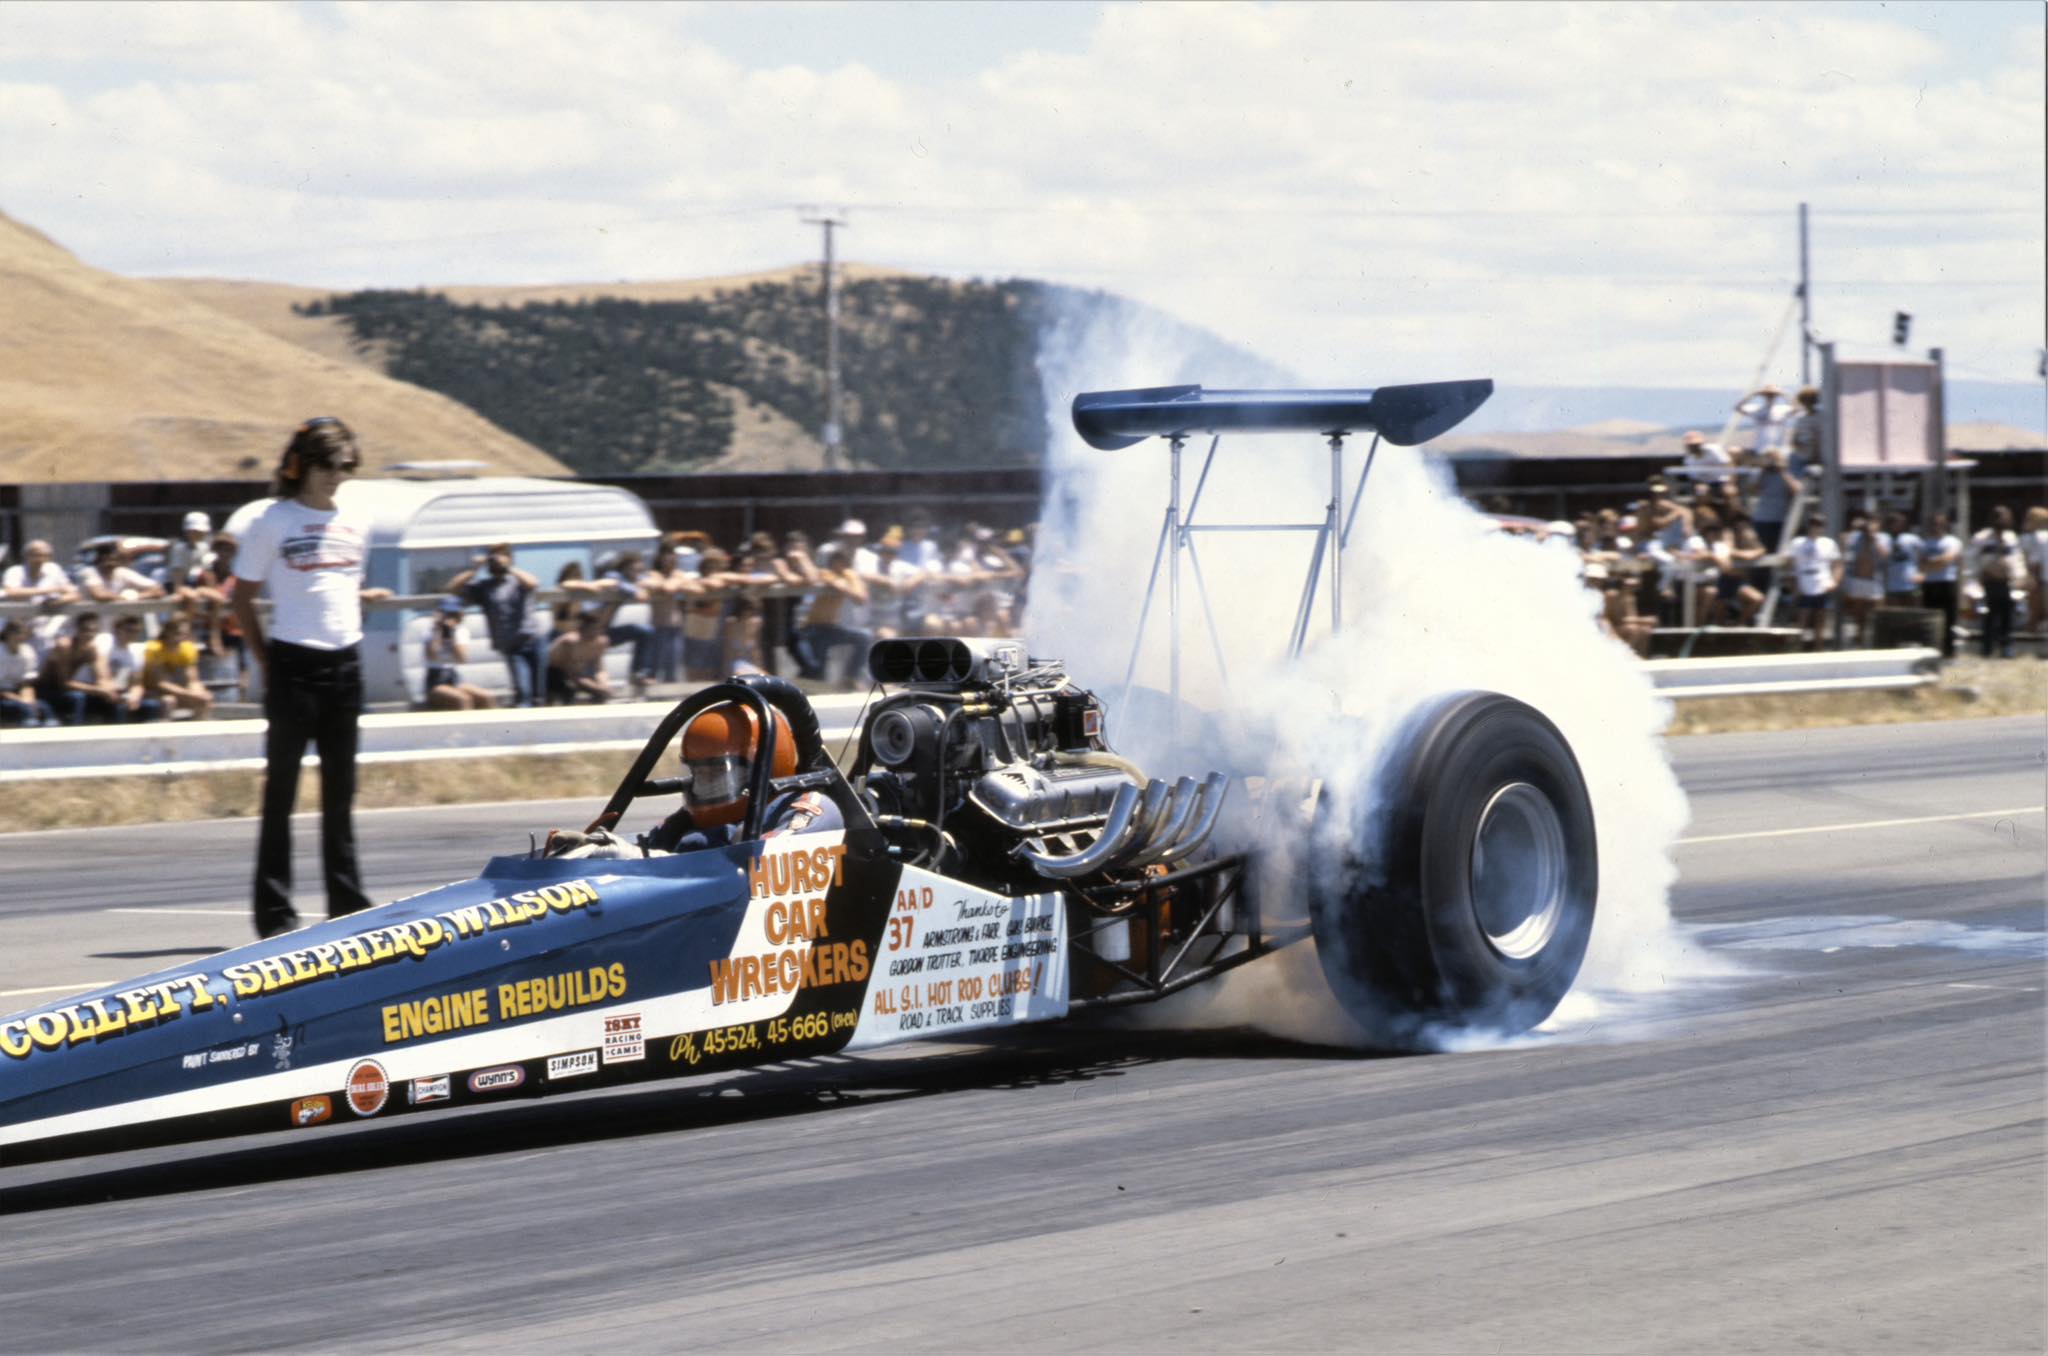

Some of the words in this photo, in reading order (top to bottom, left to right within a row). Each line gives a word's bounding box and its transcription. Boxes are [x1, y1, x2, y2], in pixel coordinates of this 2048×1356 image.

[748, 844, 847, 899] HURST
[897, 887, 933, 912] AA/D
[953, 900, 993, 921] Thanks
[994, 902, 1011, 918] to
[765, 898, 829, 945] CAR
[888, 916, 914, 952] 37
[922, 924, 974, 949] ARMSTRONG
[0, 973, 228, 1058] COLLETT,
[222, 917, 453, 996] SHEPHERD,
[435, 879, 599, 935] WILSON
[710, 939, 869, 1006] WRECKERS
[889, 954, 923, 976] GORDON
[1000, 937, 1058, 962] ENGINEERING
[382, 988, 490, 1043] ENGINE
[498, 962, 627, 1020] REBUILDS
[874, 987, 897, 1015] ALL
[927, 979, 953, 1007] HOT
[957, 975, 983, 1002] ROD
[899, 1011, 922, 1031] ROAD
[936, 1005, 964, 1026] TRACK
[970, 999, 1012, 1020] SUPPLIES
[605, 1033, 642, 1045] RACING
[551, 1053, 595, 1072] SIMPSON
